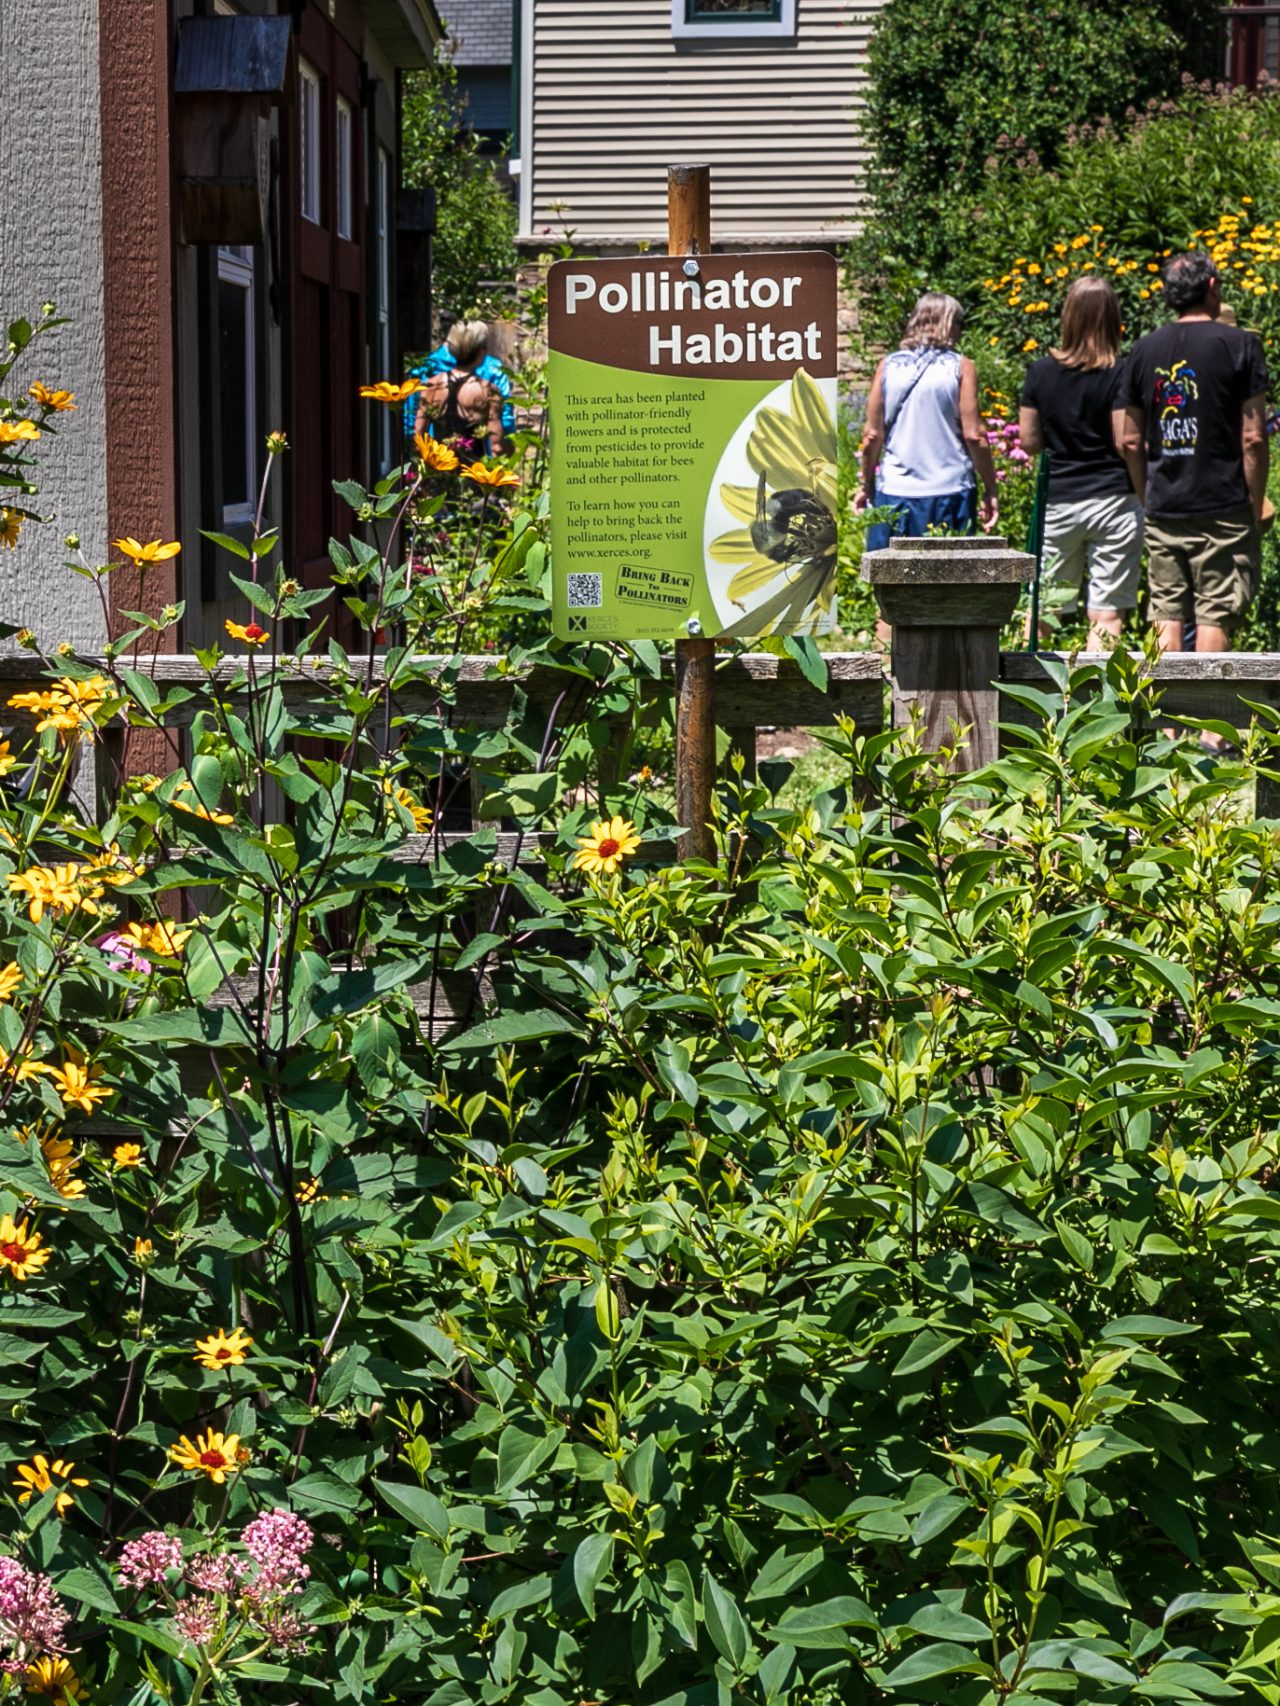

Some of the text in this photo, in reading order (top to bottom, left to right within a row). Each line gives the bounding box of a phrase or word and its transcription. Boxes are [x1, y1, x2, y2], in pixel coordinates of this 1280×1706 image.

[565, 270, 802, 314] Pollinator
[649, 322, 822, 365] Habitat
[565, 391, 705, 405] This area has been planted
[566, 408, 691, 423] with pollinator-friendly
[566, 424, 691, 437] flowers and is protected
[566, 439, 704, 455] from pesticides to provide
[567, 456, 694, 468] valuable habitat for bees
[567, 473, 680, 485] and other pollinators.
[567, 499, 680, 512] To learn how you can
[567, 514, 682, 529] help to bring back the
[568, 530, 687, 545] pollinators, please visit
[568, 548, 652, 558] www.xerces.org.
